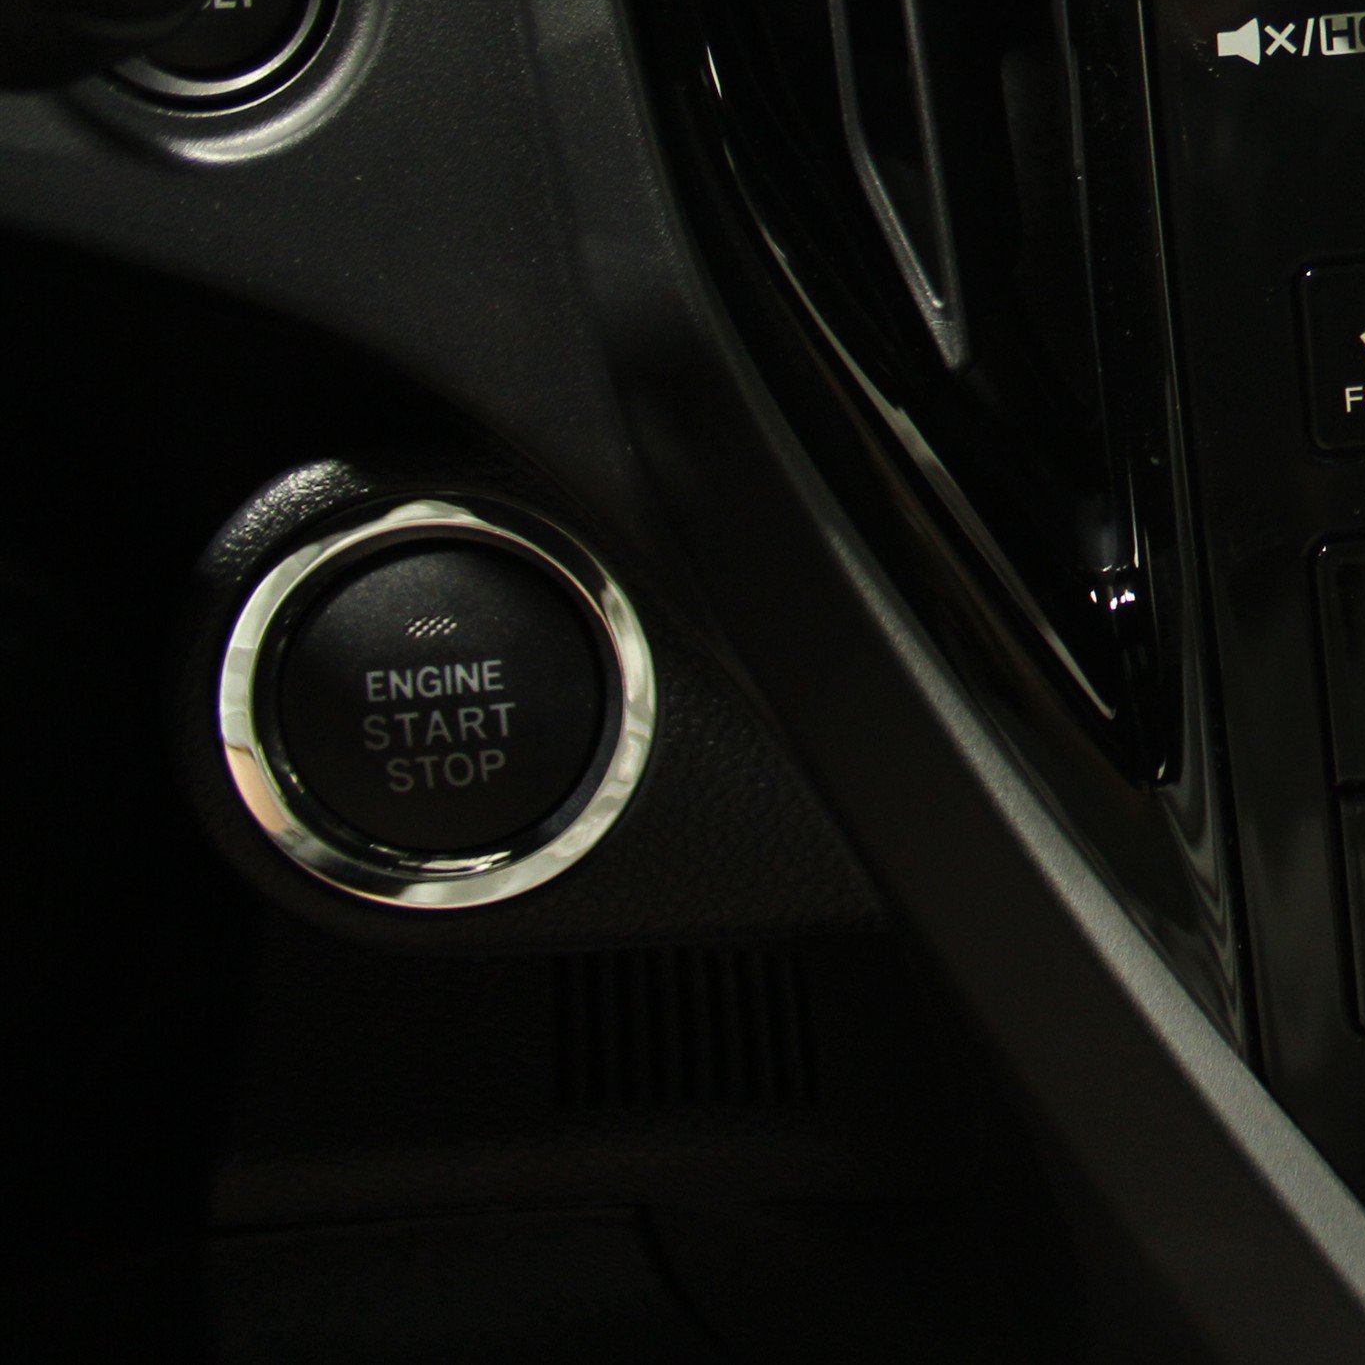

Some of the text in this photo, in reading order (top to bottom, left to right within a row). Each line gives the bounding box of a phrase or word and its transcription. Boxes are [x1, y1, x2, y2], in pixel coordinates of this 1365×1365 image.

[365, 659, 505, 703] ENGINE
[362, 701, 518, 752] START
[386, 748, 508, 794] STOP
